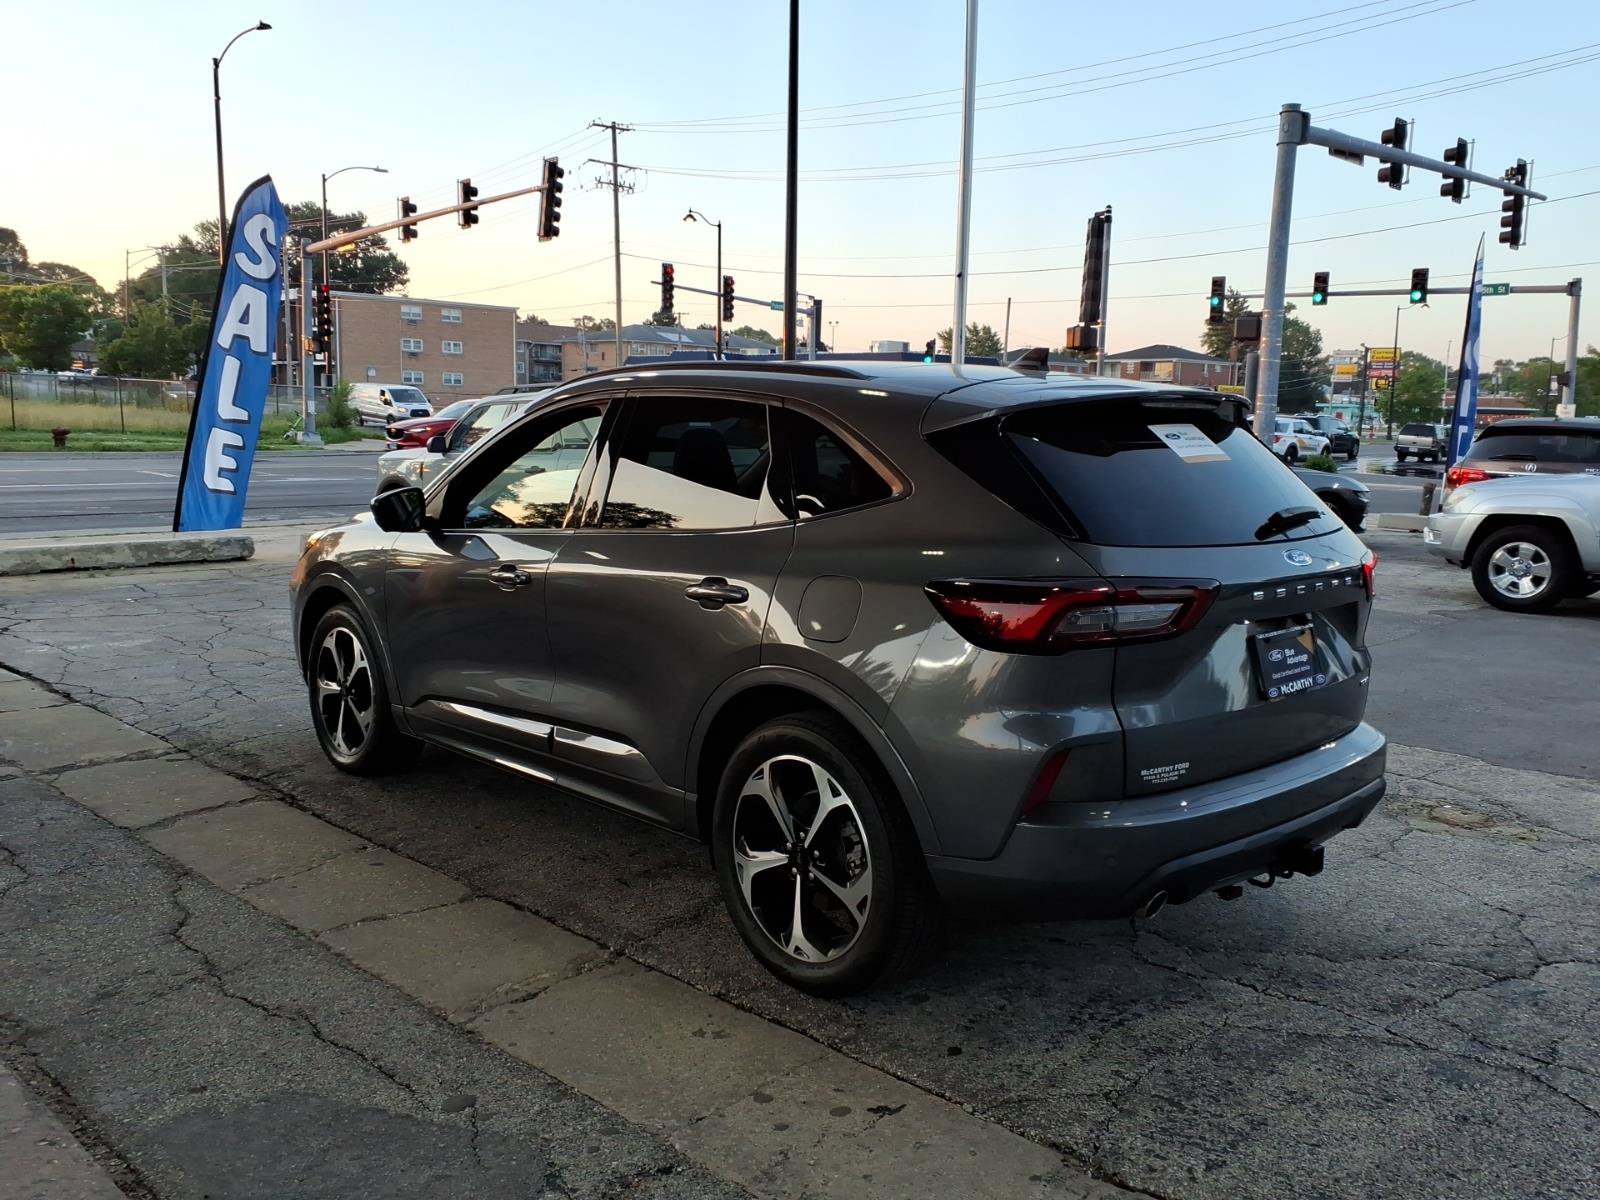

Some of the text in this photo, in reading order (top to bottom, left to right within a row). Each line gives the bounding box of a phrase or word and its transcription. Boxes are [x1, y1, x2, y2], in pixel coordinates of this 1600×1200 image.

[203, 213, 277, 494] SALE
[1280, 677, 1314, 695] McCARTHY
[1141, 762, 1190, 776] McCARTHY FORD
